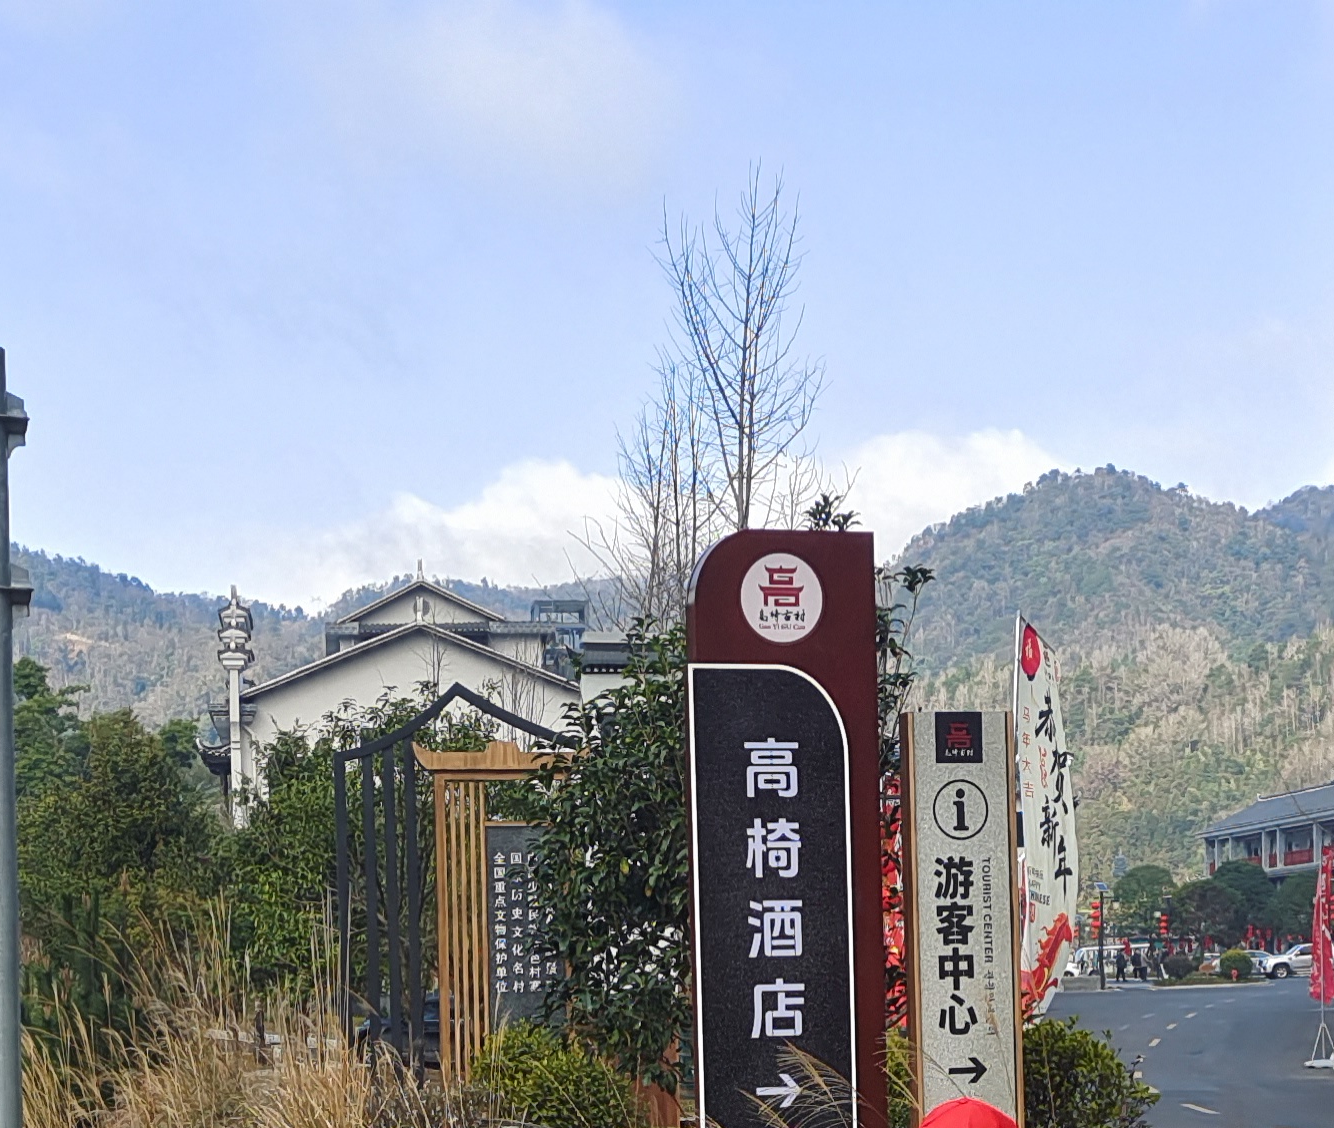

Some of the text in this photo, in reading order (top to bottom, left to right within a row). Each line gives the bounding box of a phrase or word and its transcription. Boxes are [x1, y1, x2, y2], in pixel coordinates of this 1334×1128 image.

[494, 852, 508, 993] 全国重点文物保护单位
[743, 737, 805, 1039] 高椅酒店
[934, 856, 978, 1035] 游客中心
[982, 857, 993, 963] TOURIST CENTER
